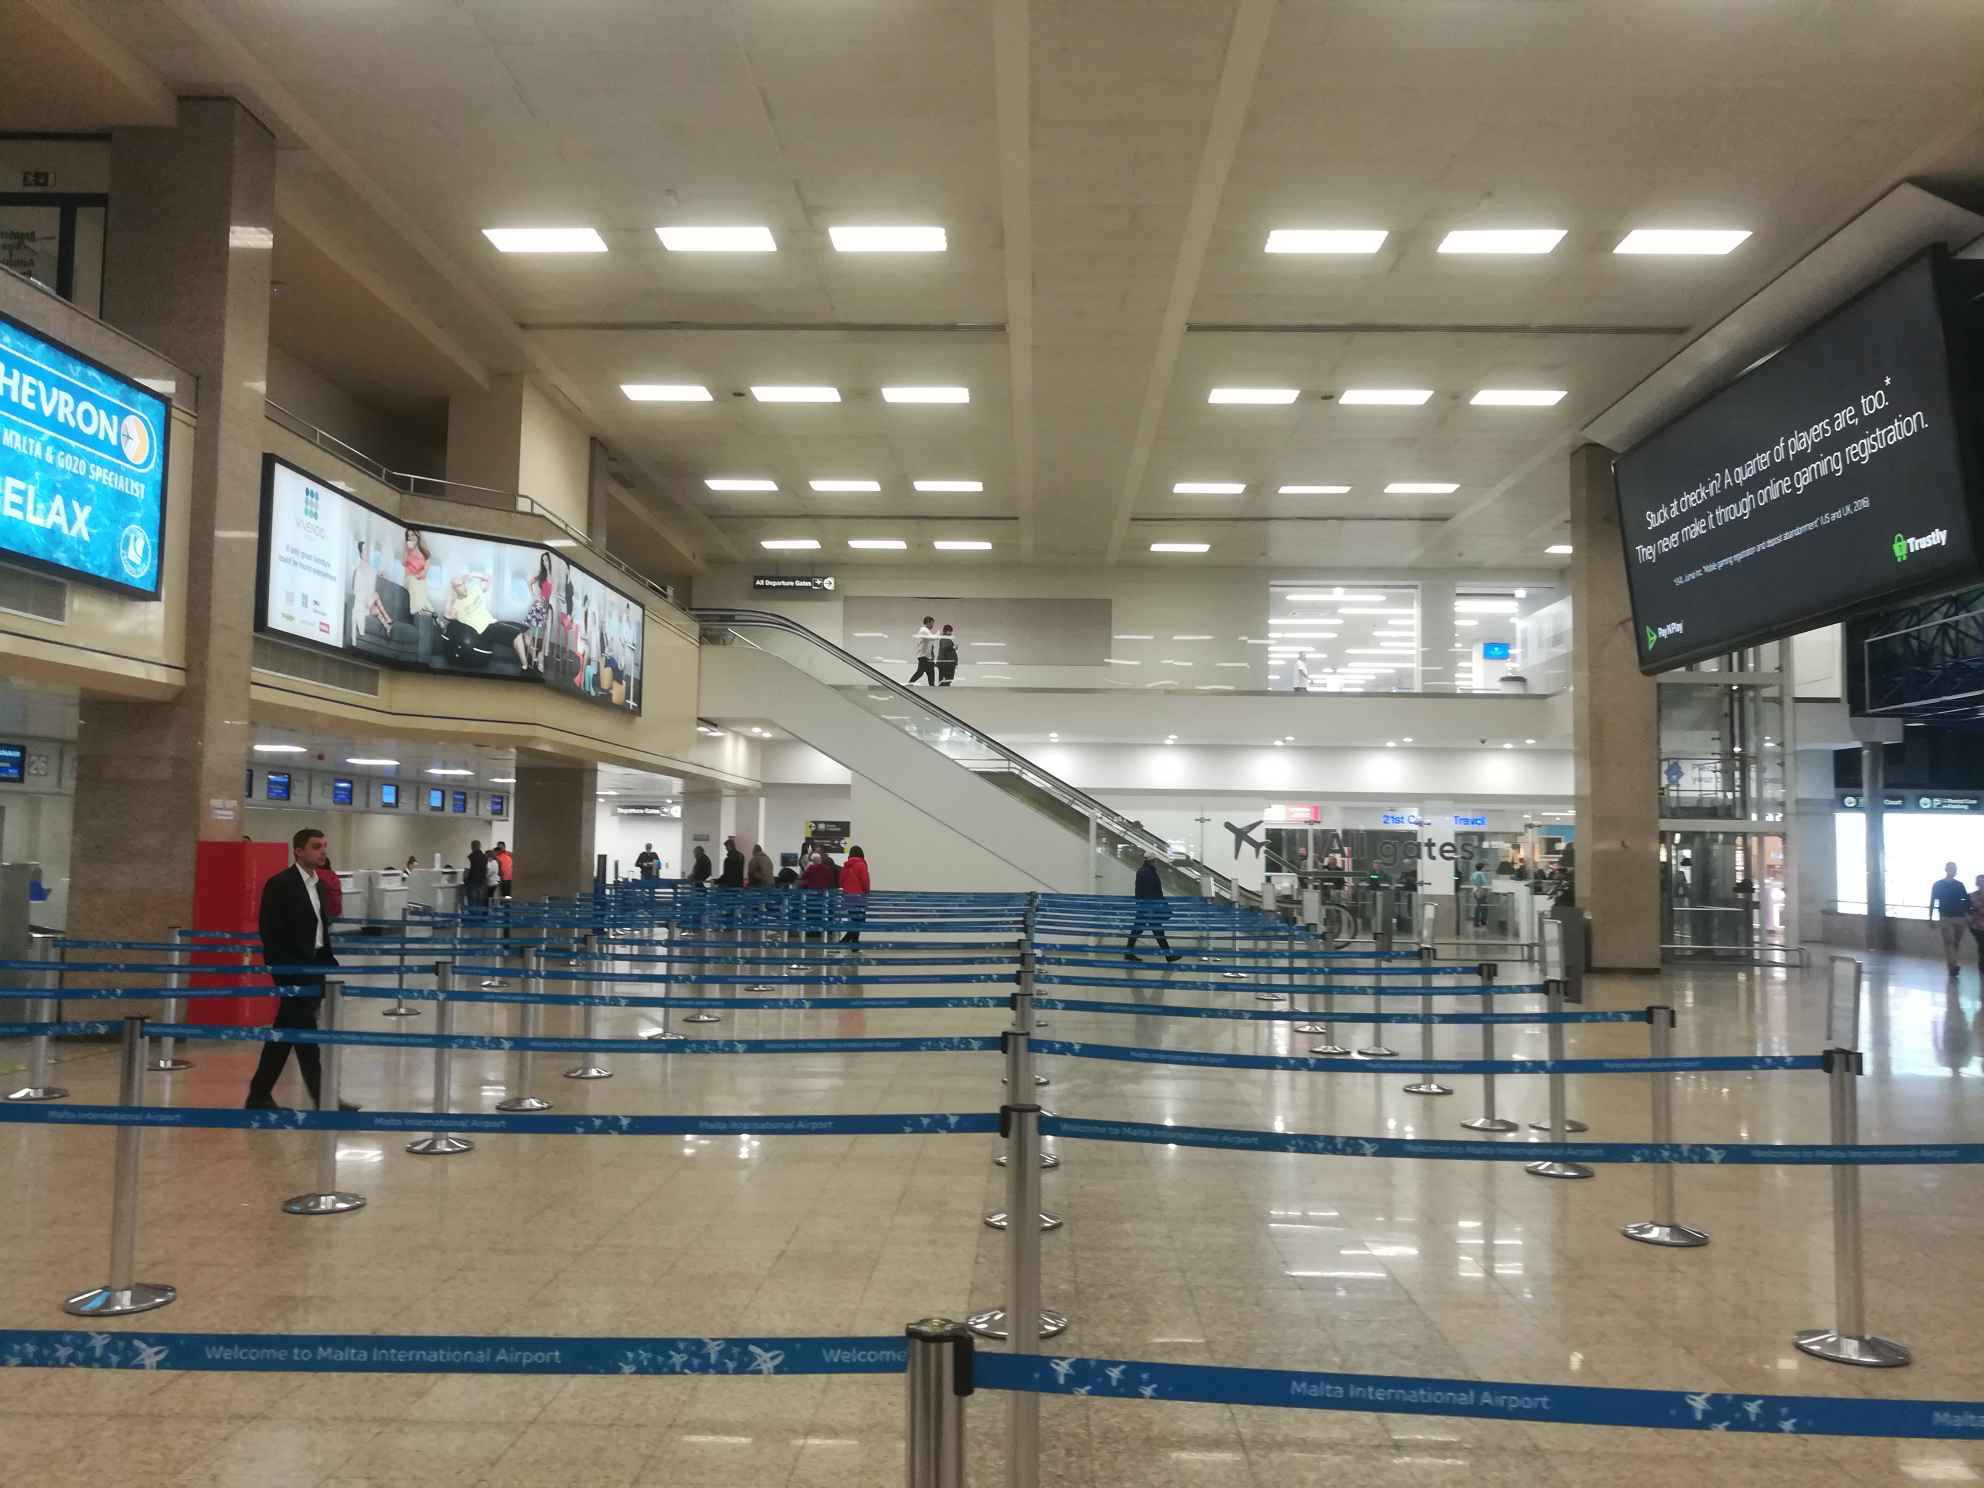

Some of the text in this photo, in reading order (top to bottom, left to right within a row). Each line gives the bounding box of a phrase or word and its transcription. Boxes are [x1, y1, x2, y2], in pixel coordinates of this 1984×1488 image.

[3, 427, 147, 500] MALTA & GOZO SPECIALIST
[1646, 504, 1670, 530] Stuck
[1670, 498, 1680, 518] at
[1680, 472, 1721, 512] check-in?
[1724, 468, 1733, 489] A
[1733, 450, 1771, 487] quarter
[1773, 437, 1785, 463] of
[1787, 419, 1832, 461] players
[1833, 405, 1859, 432] are,
[1635, 411, 1929, 564] They never make it through online gaming registration.
[1906, 528, 1948, 553] Trustly
[1379, 838, 1474, 866] gates
[205, 1345, 561, 1367] Welcome to Malta International Airport
[821, 1347, 907, 1363] Welcome
[1290, 1380, 1552, 1411] Malta International Airport
